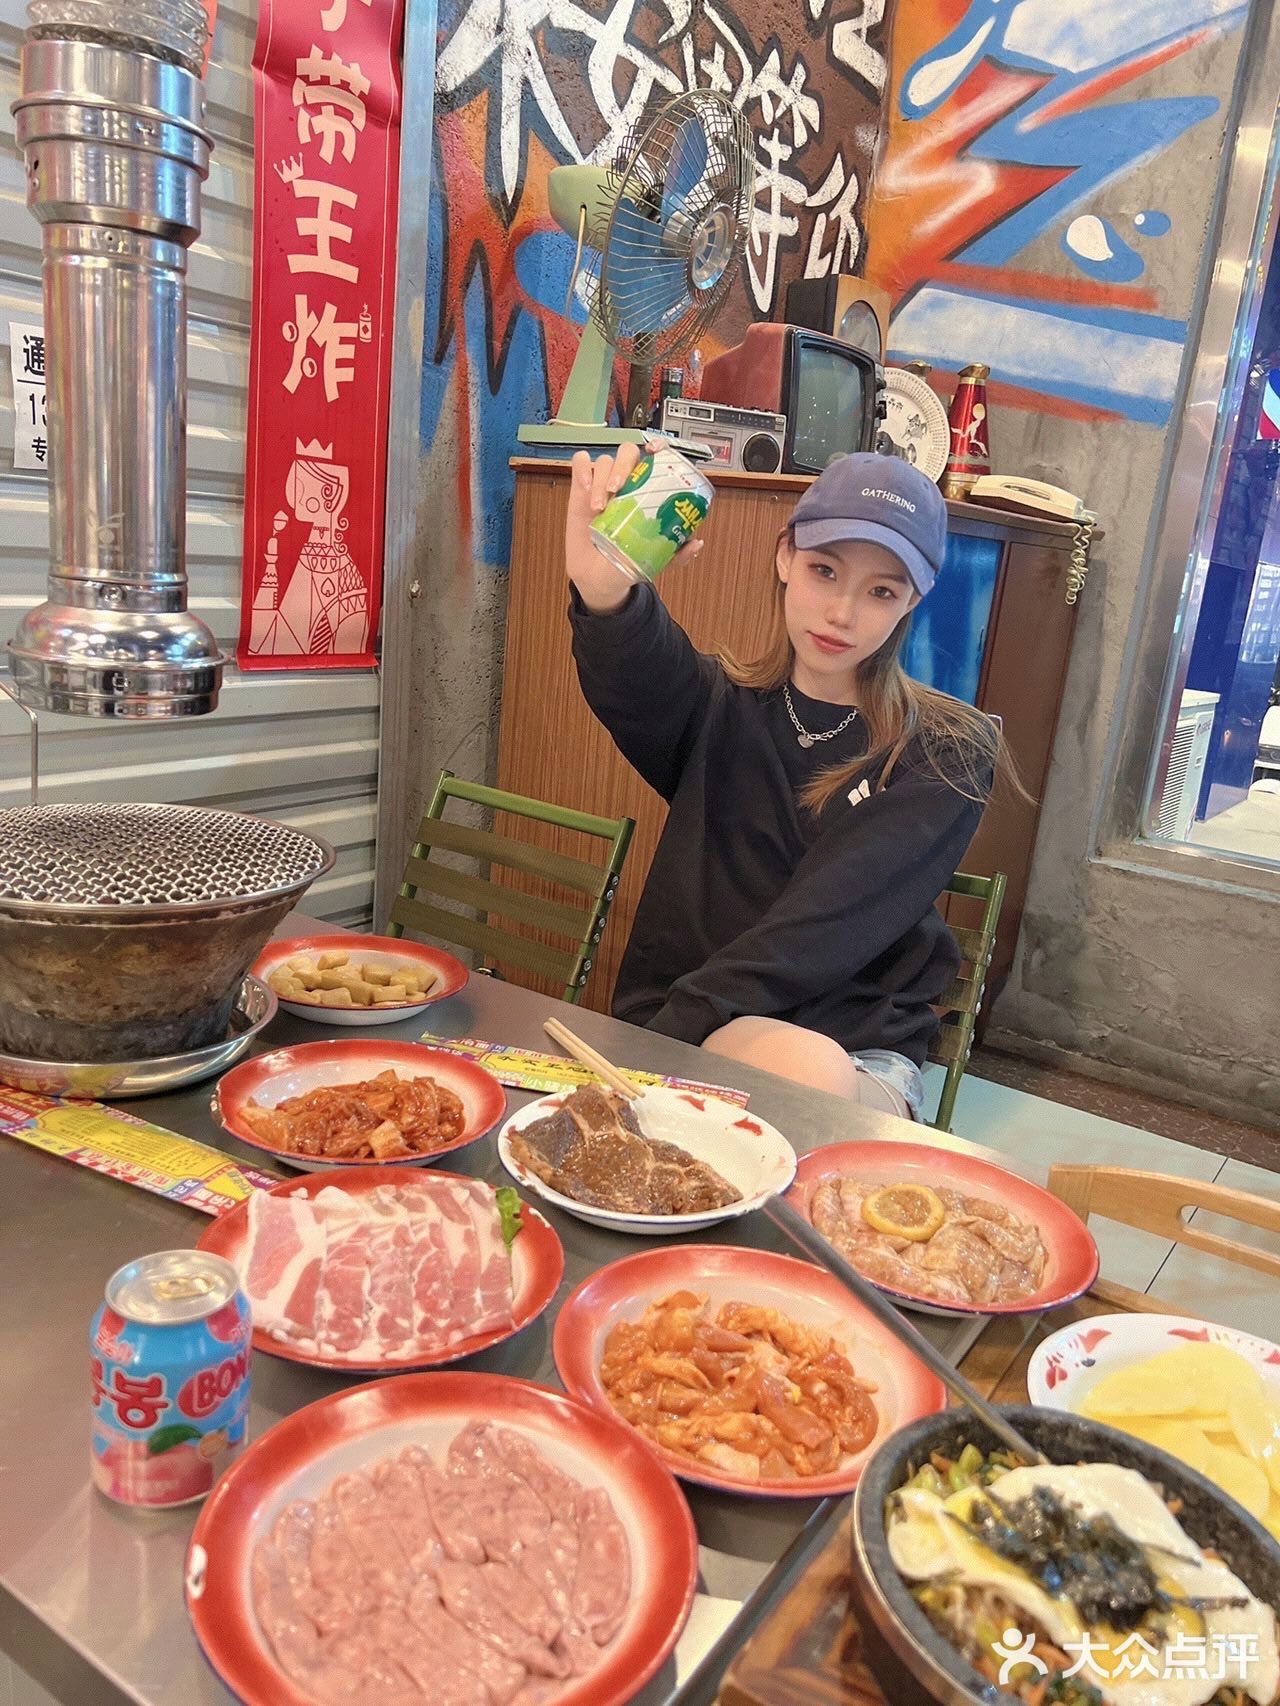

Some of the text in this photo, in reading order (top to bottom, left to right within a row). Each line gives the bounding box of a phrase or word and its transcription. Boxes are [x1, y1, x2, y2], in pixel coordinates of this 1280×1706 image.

[281, 0, 372, 402] 劳王炸
[861, 487, 916, 513] GATHERING
